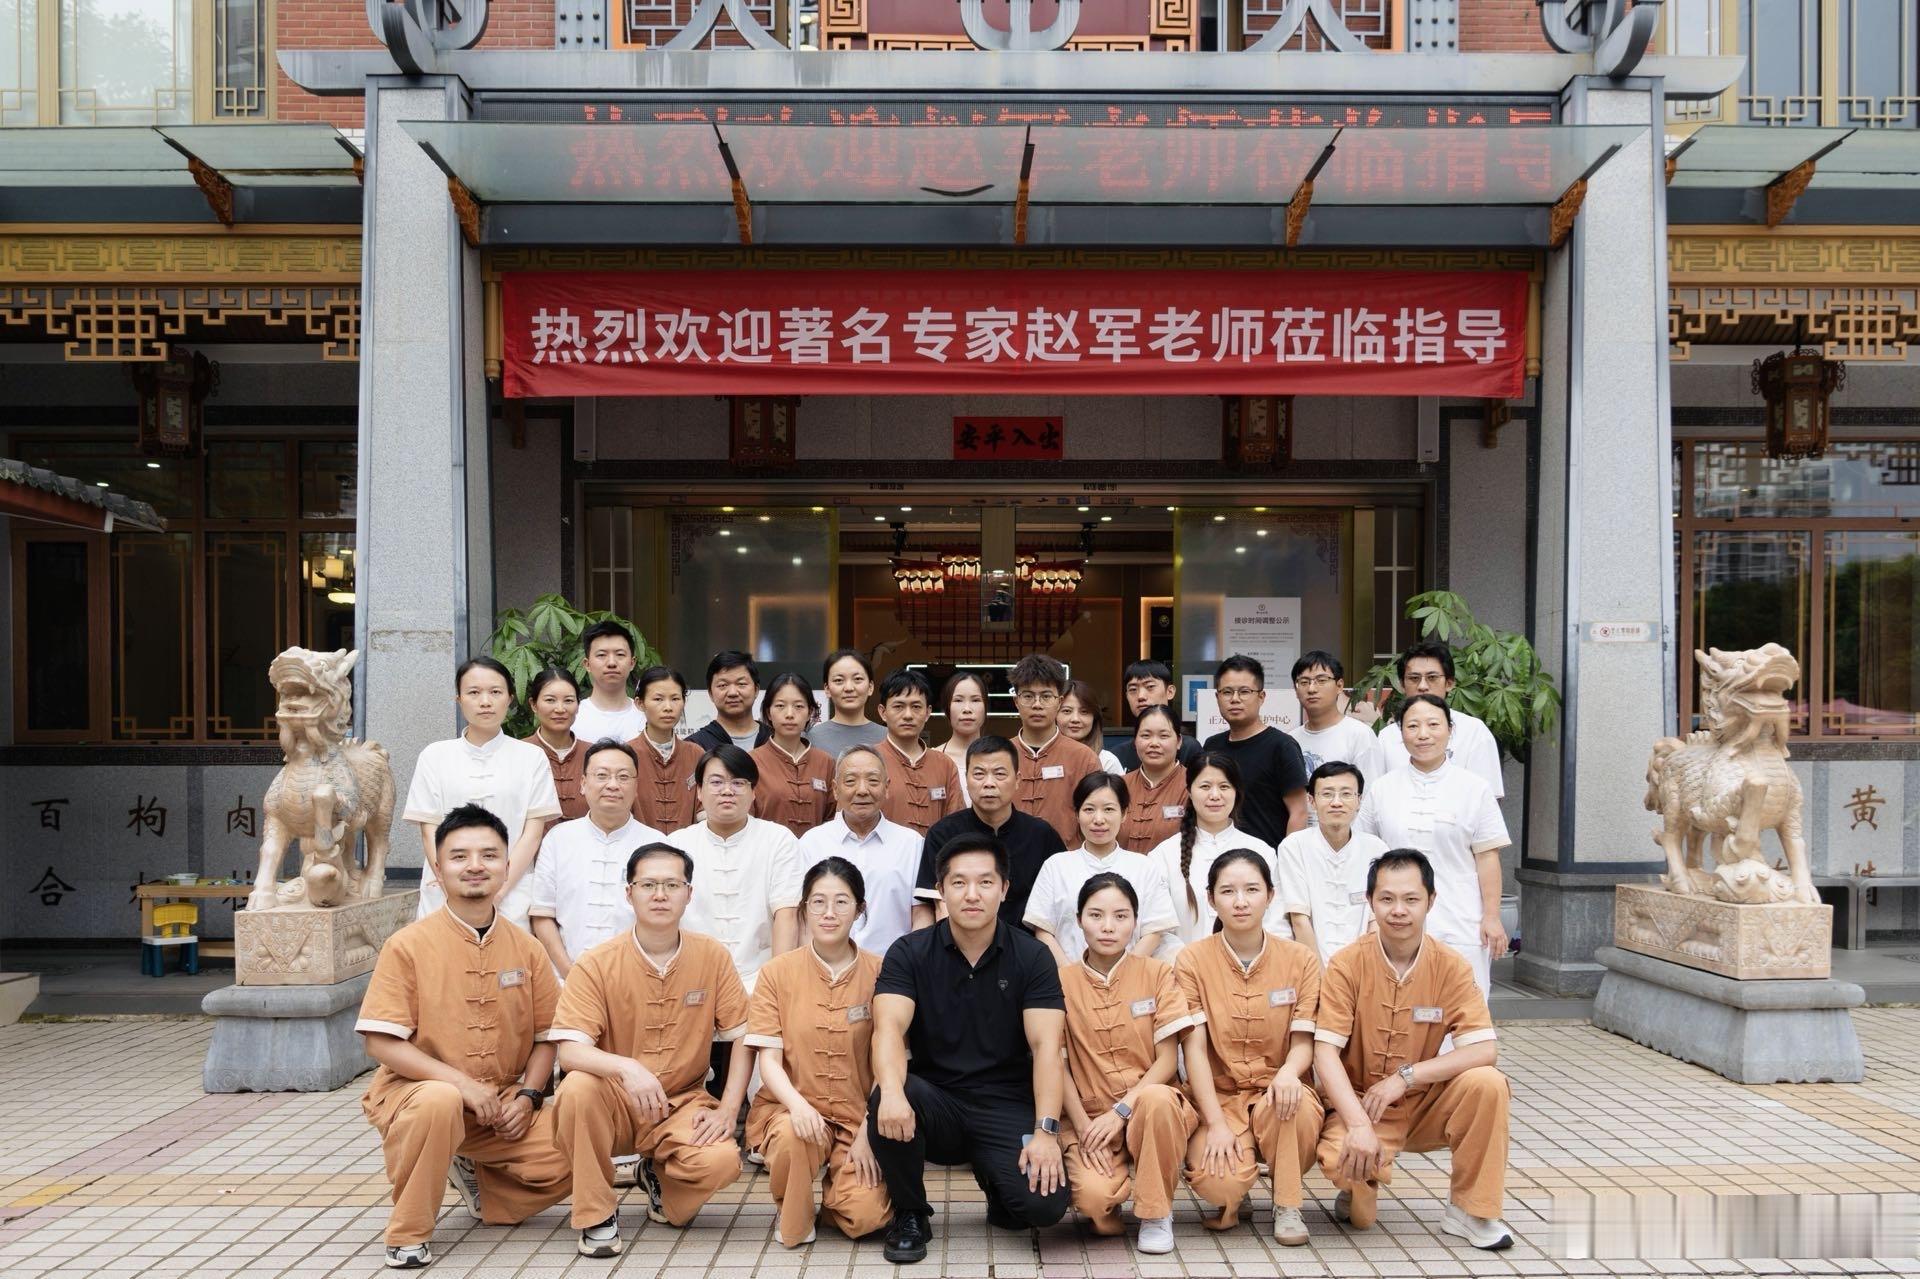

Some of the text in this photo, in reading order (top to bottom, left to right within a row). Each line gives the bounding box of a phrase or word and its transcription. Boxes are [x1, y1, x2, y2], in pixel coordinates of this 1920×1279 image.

[530, 306, 1507, 366] 热烈欢迎著名专家赵军老师莅临指导
[957, 423, 1060, 452] 出入平安
[28, 797, 77, 907] 百合
